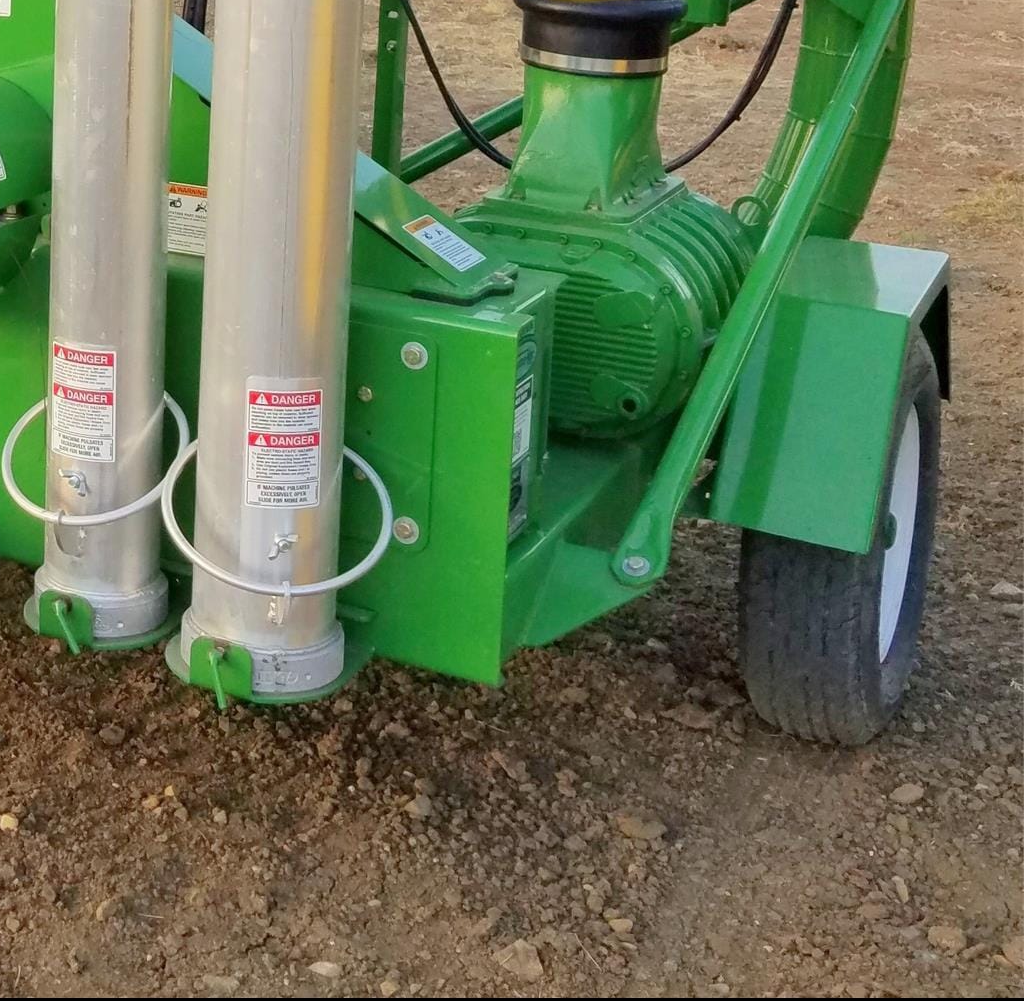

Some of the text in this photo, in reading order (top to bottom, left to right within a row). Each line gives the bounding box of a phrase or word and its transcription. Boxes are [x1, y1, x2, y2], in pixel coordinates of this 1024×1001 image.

[67, 351, 108, 365] DANGER
[66, 390, 107, 404] DANGER
[271, 394, 316, 405] DANGER
[270, 435, 315, 447] DANGER
